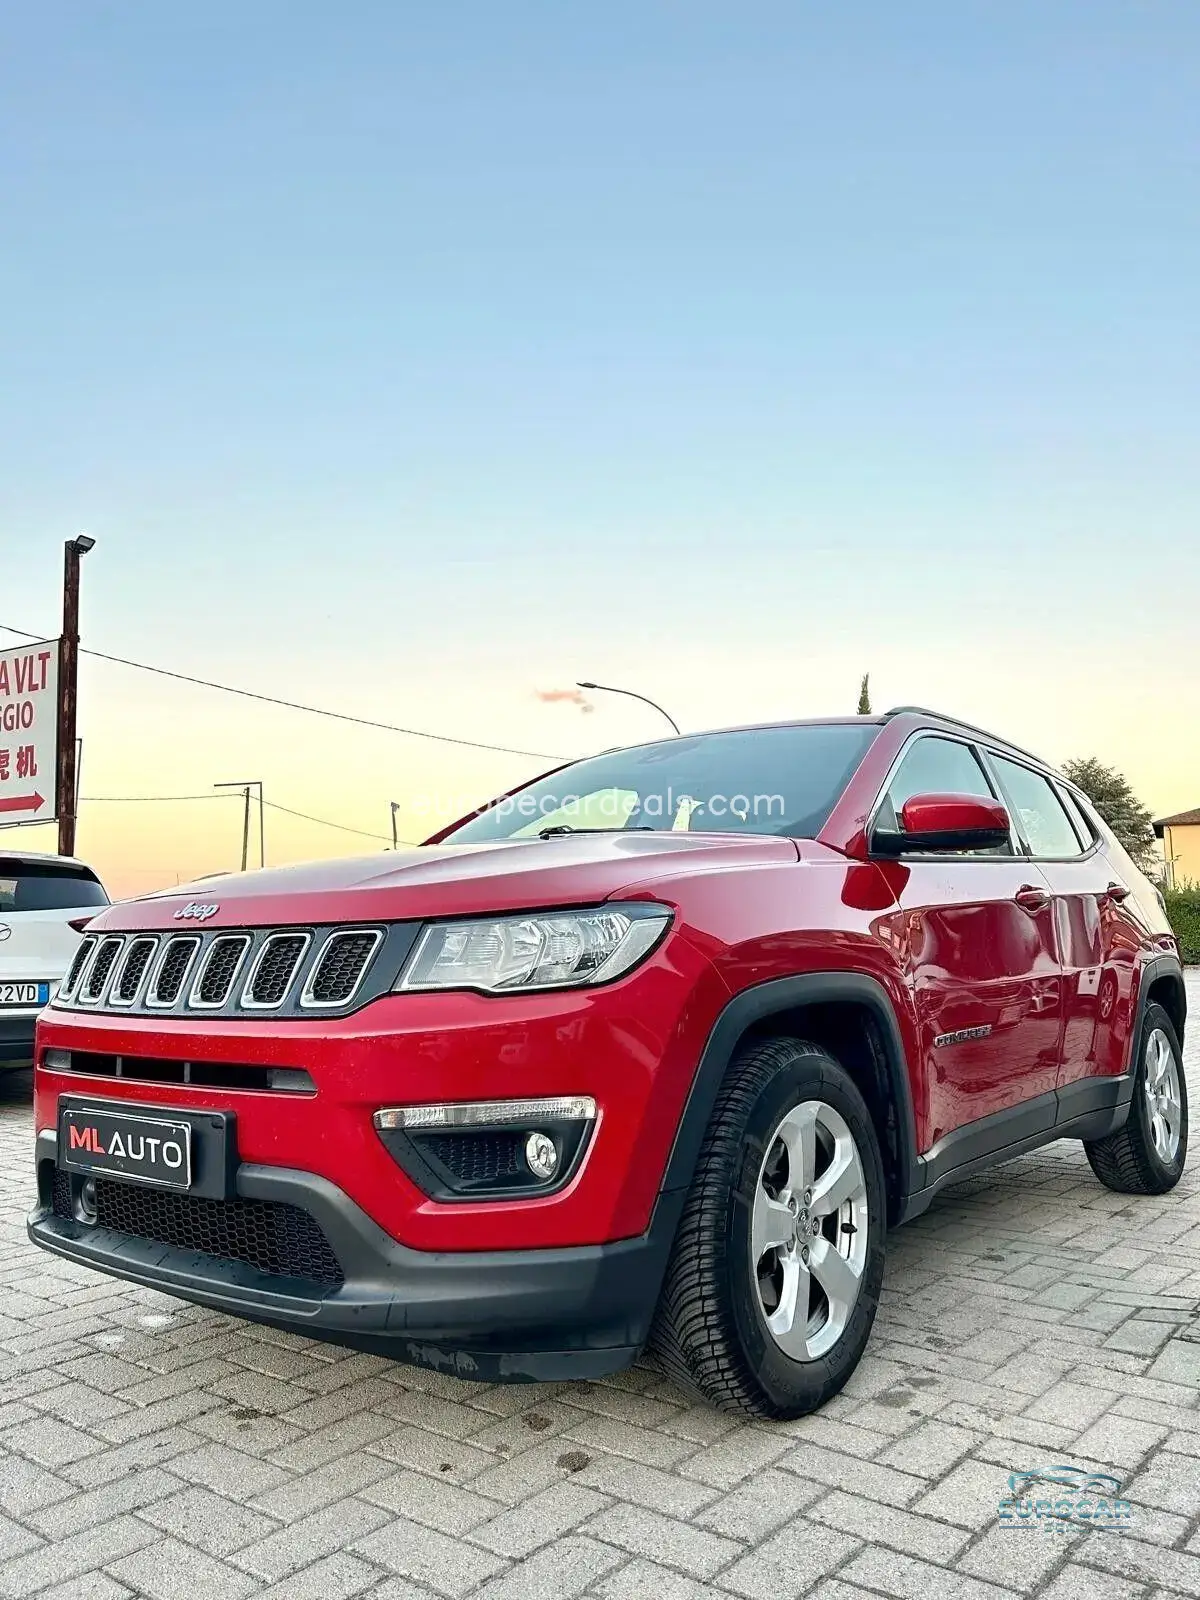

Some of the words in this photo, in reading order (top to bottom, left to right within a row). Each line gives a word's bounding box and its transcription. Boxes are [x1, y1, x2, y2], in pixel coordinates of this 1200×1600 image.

[14, 651, 51, 694] VLT
[0, 700, 34, 732] GIO
[173, 901, 220, 922] Jeep
[0, 985, 36, 1002] 2VD
